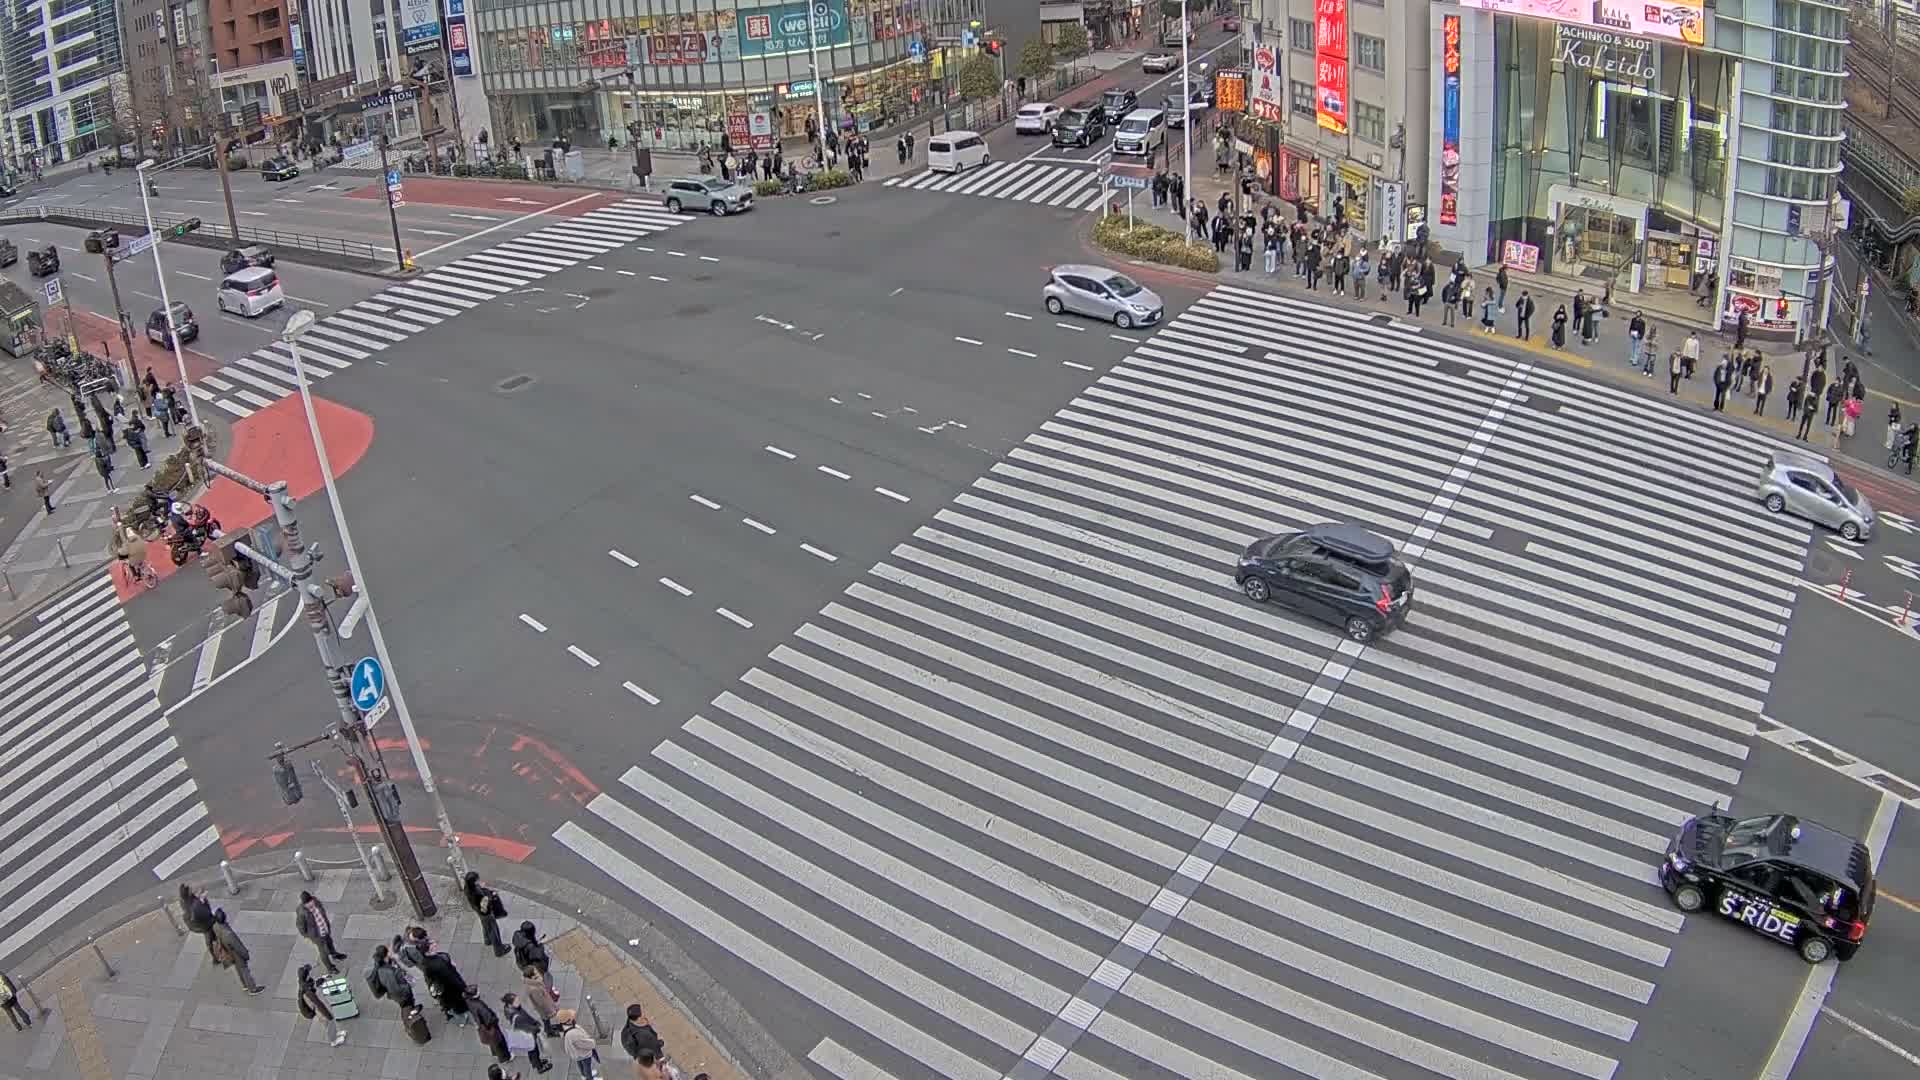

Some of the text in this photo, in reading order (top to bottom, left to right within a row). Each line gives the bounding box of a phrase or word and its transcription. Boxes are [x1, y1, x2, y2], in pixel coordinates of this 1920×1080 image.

[1551, 38, 1655, 79] Kaleido
[1557, 25, 1651, 52] PACHINKO & SLOT
[1719, 896, 1799, 941] S.RIDE
